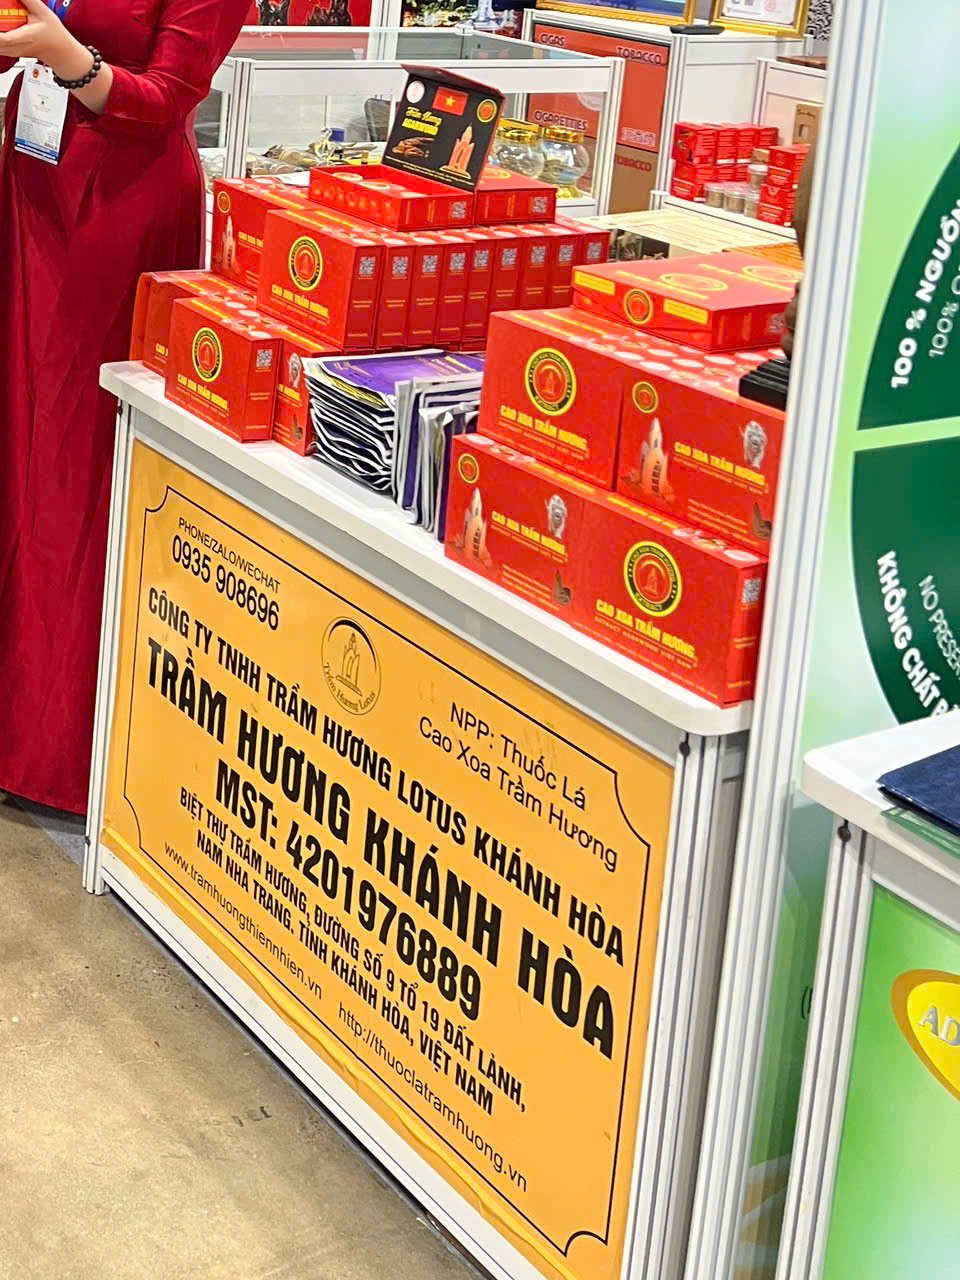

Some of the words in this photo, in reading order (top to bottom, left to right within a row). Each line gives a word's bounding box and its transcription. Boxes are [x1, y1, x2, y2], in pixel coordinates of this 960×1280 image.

[540, 33, 566, 47] CIGAS
[616, 47, 662, 65] TOBACCO
[891, 337, 917, 388] 100
[905, 308, 927, 330] %
[929, 301, 960, 357] 100%
[172, 534, 211, 583] 0935
[215, 564, 280, 631] 908696
[178, 516, 281, 594] PHONE/ZALO/WECHAT
[877, 550, 913, 650] KHÔNG
[919, 574, 939, 611] NO
[595, 599, 615, 617] CAO
[614, 606, 634, 628] XOA
[148, 587, 190, 640] CÔNG
[194, 619, 213, 655] TY
[217, 636, 261, 693] TNHH
[266, 671, 318, 736] TRẦM
[322, 714, 392, 791] HƯƠNG
[397, 769, 467, 846] LOTUS
[474, 825, 561, 918] KHÁNH
[568, 894, 624, 967] HÒA
[419, 716, 452, 753] Cao
[456, 739, 491, 782] Xoa
[496, 766, 542, 817] Trầm
[548, 802, 618, 873] Hương
[450, 701, 495, 749] NPP:
[500, 734, 557, 790] Thuốc
[562, 775, 586, 811] Lá
[147, 636, 228, 746] TRẦM
[237, 708, 351, 846] HƯƠNG
[363, 807, 503, 968] KHÁNH
[517, 926, 614, 1061] HÒA
[215, 757, 279, 850] MST:
[285, 819, 482, 1022] 4201976889
[164, 840, 323, 1001] www.tramhuongthiennhien.vn
[180, 786, 204, 822] BIỆT
[206, 808, 229, 846] THỰ
[264, 860, 310, 919] HƯƠNG,
[313, 903, 360, 961] ĐƯỜNG
[362, 947, 384, 981] SỐ
[386, 968, 395, 993] 9
[399, 975, 420, 1013] TỔ
[422, 999, 440, 1032] 19
[443, 1014, 475, 1062] ĐẤT
[477, 1047, 527, 1113] LÀNH,
[196, 828, 223, 868] NAM
[225, 856, 250, 893] NHA
[252, 878, 295, 935] TRANG.
[330, 950, 378, 1010] KHÁNH
[381, 994, 416, 1047] HÒA,
[418, 1029, 452, 1076] VIỆT
[454, 1066, 494, 1116] NAM
[338, 1001, 528, 1194] http://thuoclatramhuong.vn
